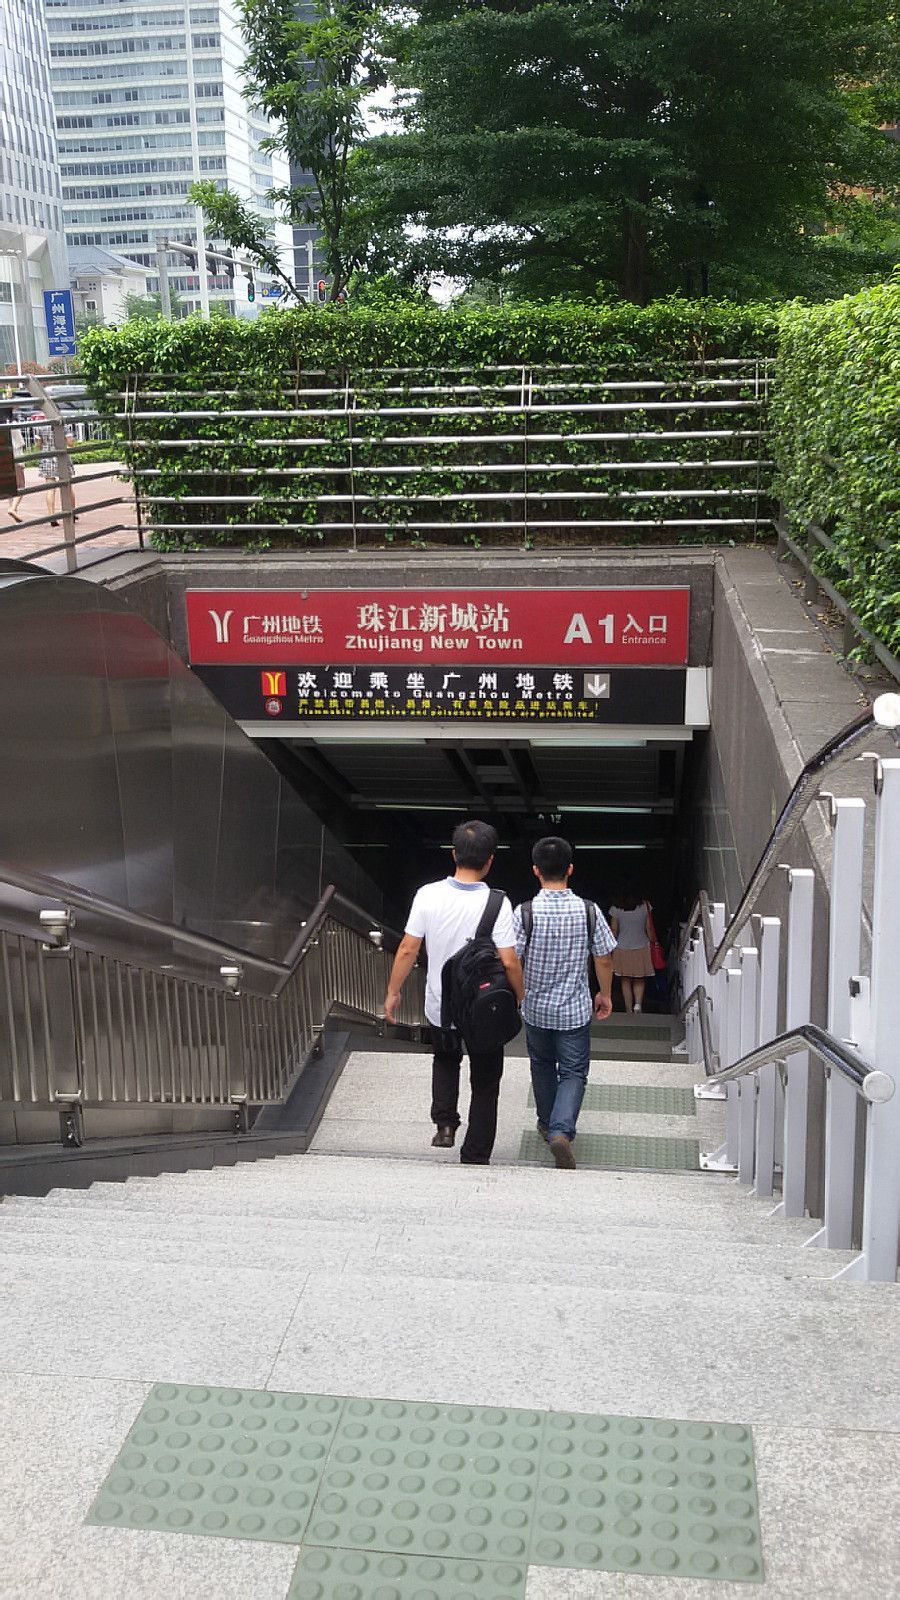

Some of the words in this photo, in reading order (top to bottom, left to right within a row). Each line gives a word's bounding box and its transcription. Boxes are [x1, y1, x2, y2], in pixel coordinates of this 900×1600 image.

[50, 292, 67, 336] 广州海关
[243, 615, 323, 634] 广州地铁
[357, 602, 509, 633] 珠江新城站
[622, 613, 667, 633] 入口
[563, 612, 614, 644] A1
[243, 634, 294, 645] Guangzhou
[294, 634, 324, 644] Metro
[345, 635, 424, 652] Zhujiang
[430, 635, 469, 649] New
[476, 635, 523, 649] Town
[622, 635, 667, 644] Entrance
[298, 671, 573, 690] 欢迎乘坐广州地铁
[298, 688, 373, 698] Welcome
[384, 689, 401, 698] to
[412, 689, 510, 700] Guangzhou
[521, 690, 573, 699] Metro
[410, 708, 427, 716] and
